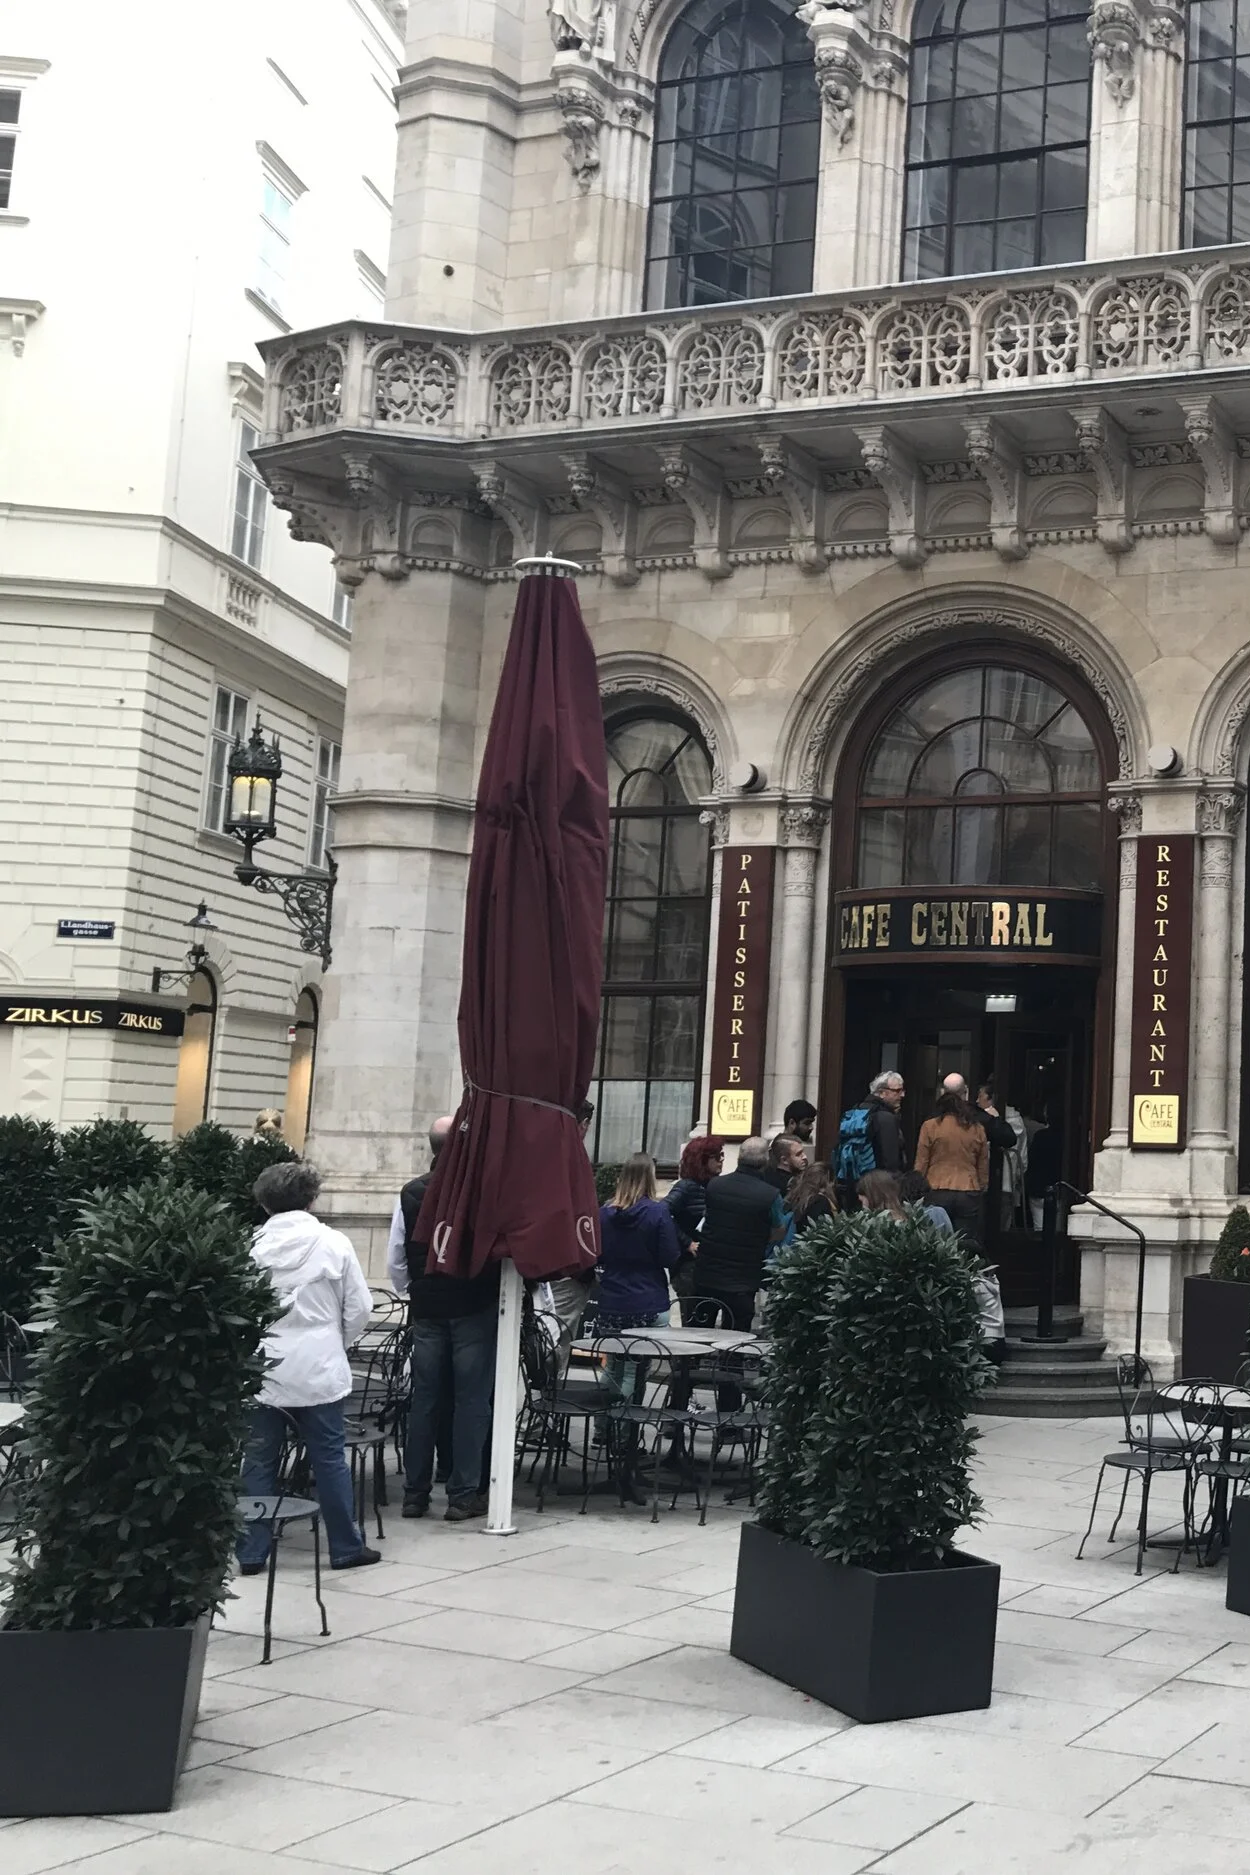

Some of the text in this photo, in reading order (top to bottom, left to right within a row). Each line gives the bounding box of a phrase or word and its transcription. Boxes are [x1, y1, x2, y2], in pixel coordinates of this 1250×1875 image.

[841, 902, 1053, 949] CAFE CENTRAL
[728, 854, 752, 1083] PATISSERIE
[1149, 845, 1171, 1087] RESTAURANT
[5, 1007, 103, 1024] ZIRKUS
[118, 1012, 163, 1031] ZIRKUS
[717, 1095, 749, 1124] CAFE
[1138, 1100, 1173, 1130] CAFE
